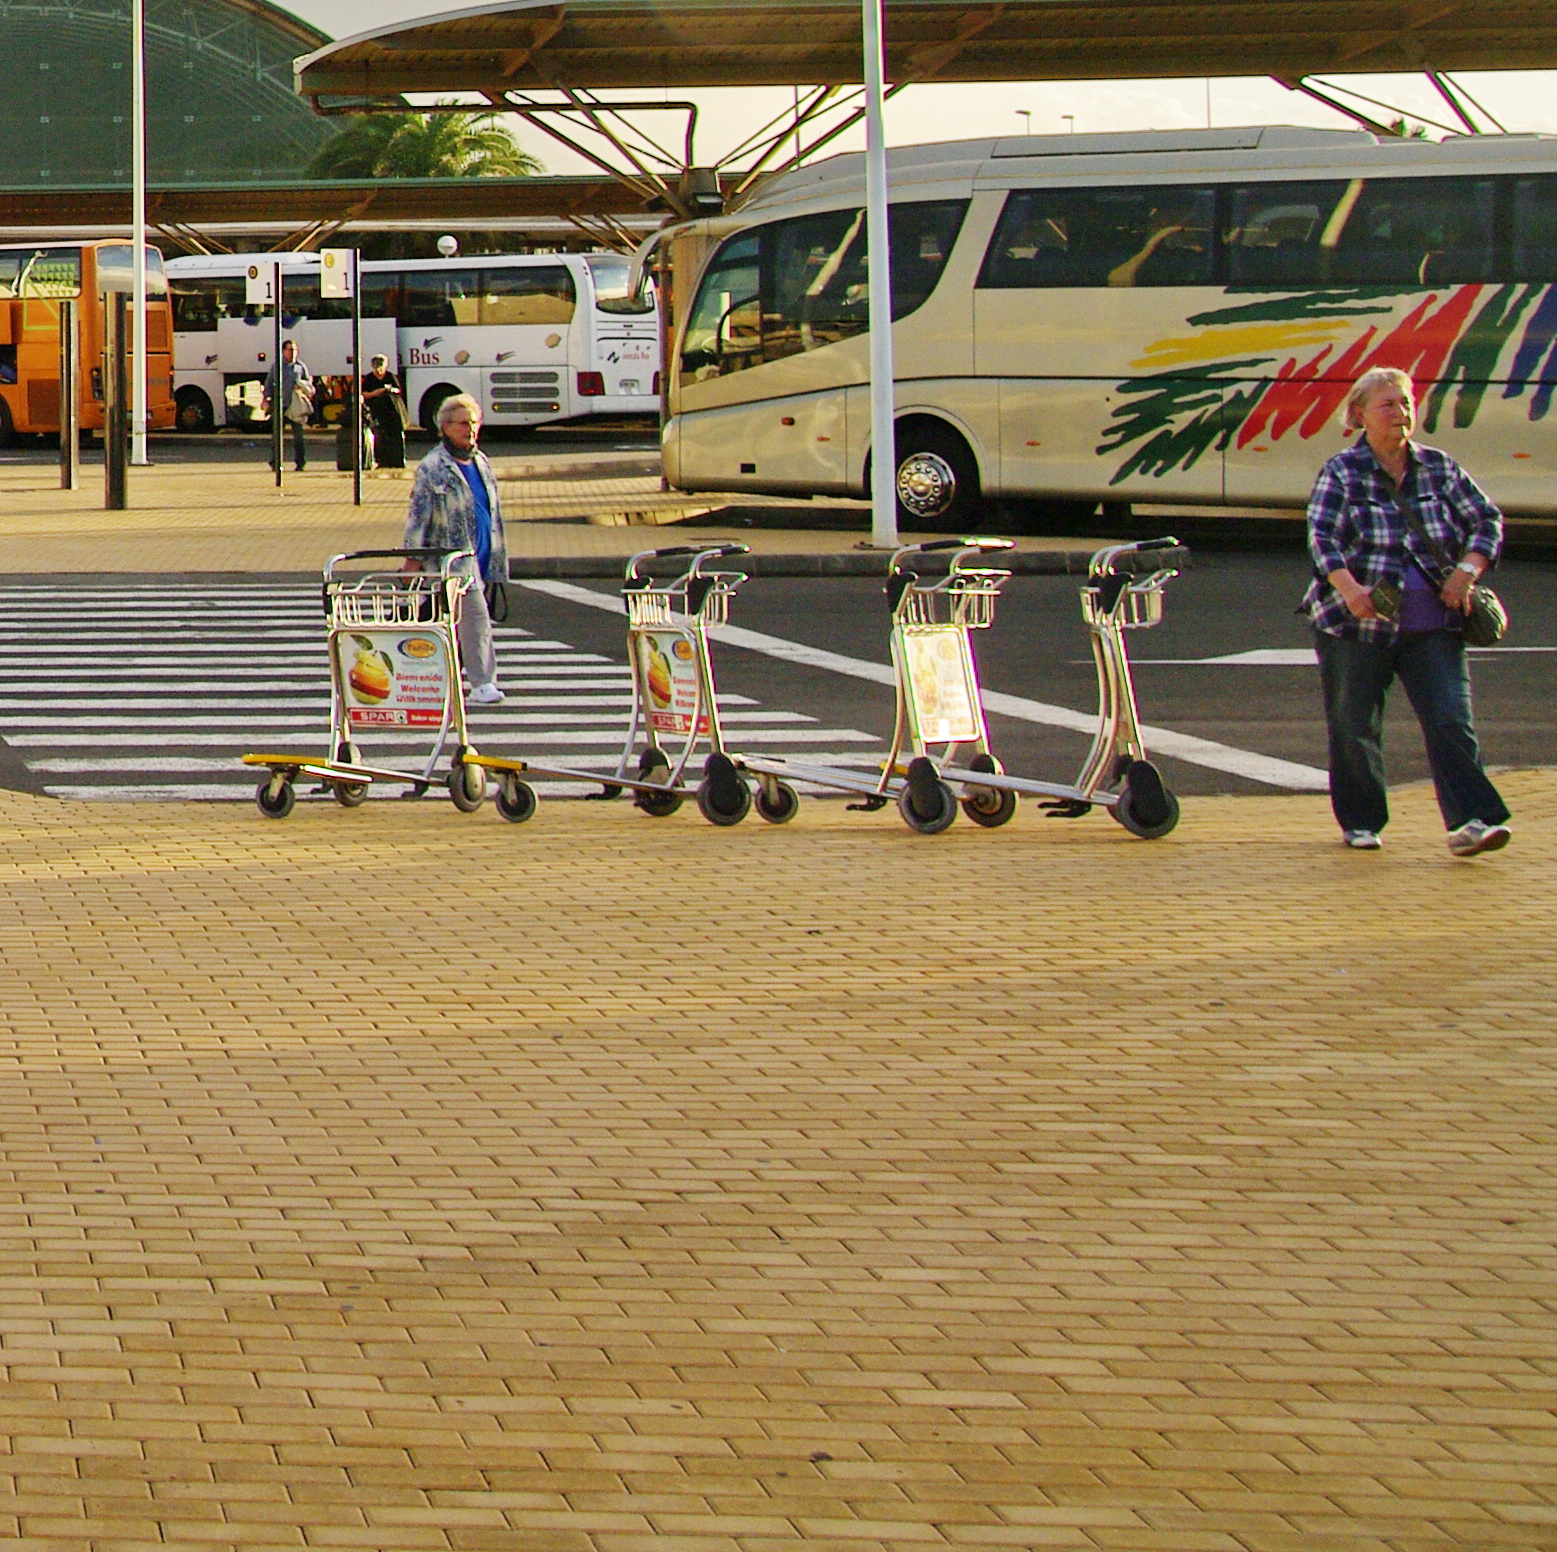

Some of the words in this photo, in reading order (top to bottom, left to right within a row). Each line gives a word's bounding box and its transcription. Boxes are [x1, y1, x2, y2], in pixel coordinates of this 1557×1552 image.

[343, 272, 350, 290] 1
[266, 282, 272, 298] 1
[410, 348, 440, 366] Bus
[396, 673, 443, 681] Bienvenido
[401, 685, 440, 693] Welcome
[360, 712, 394, 721] SPAR
